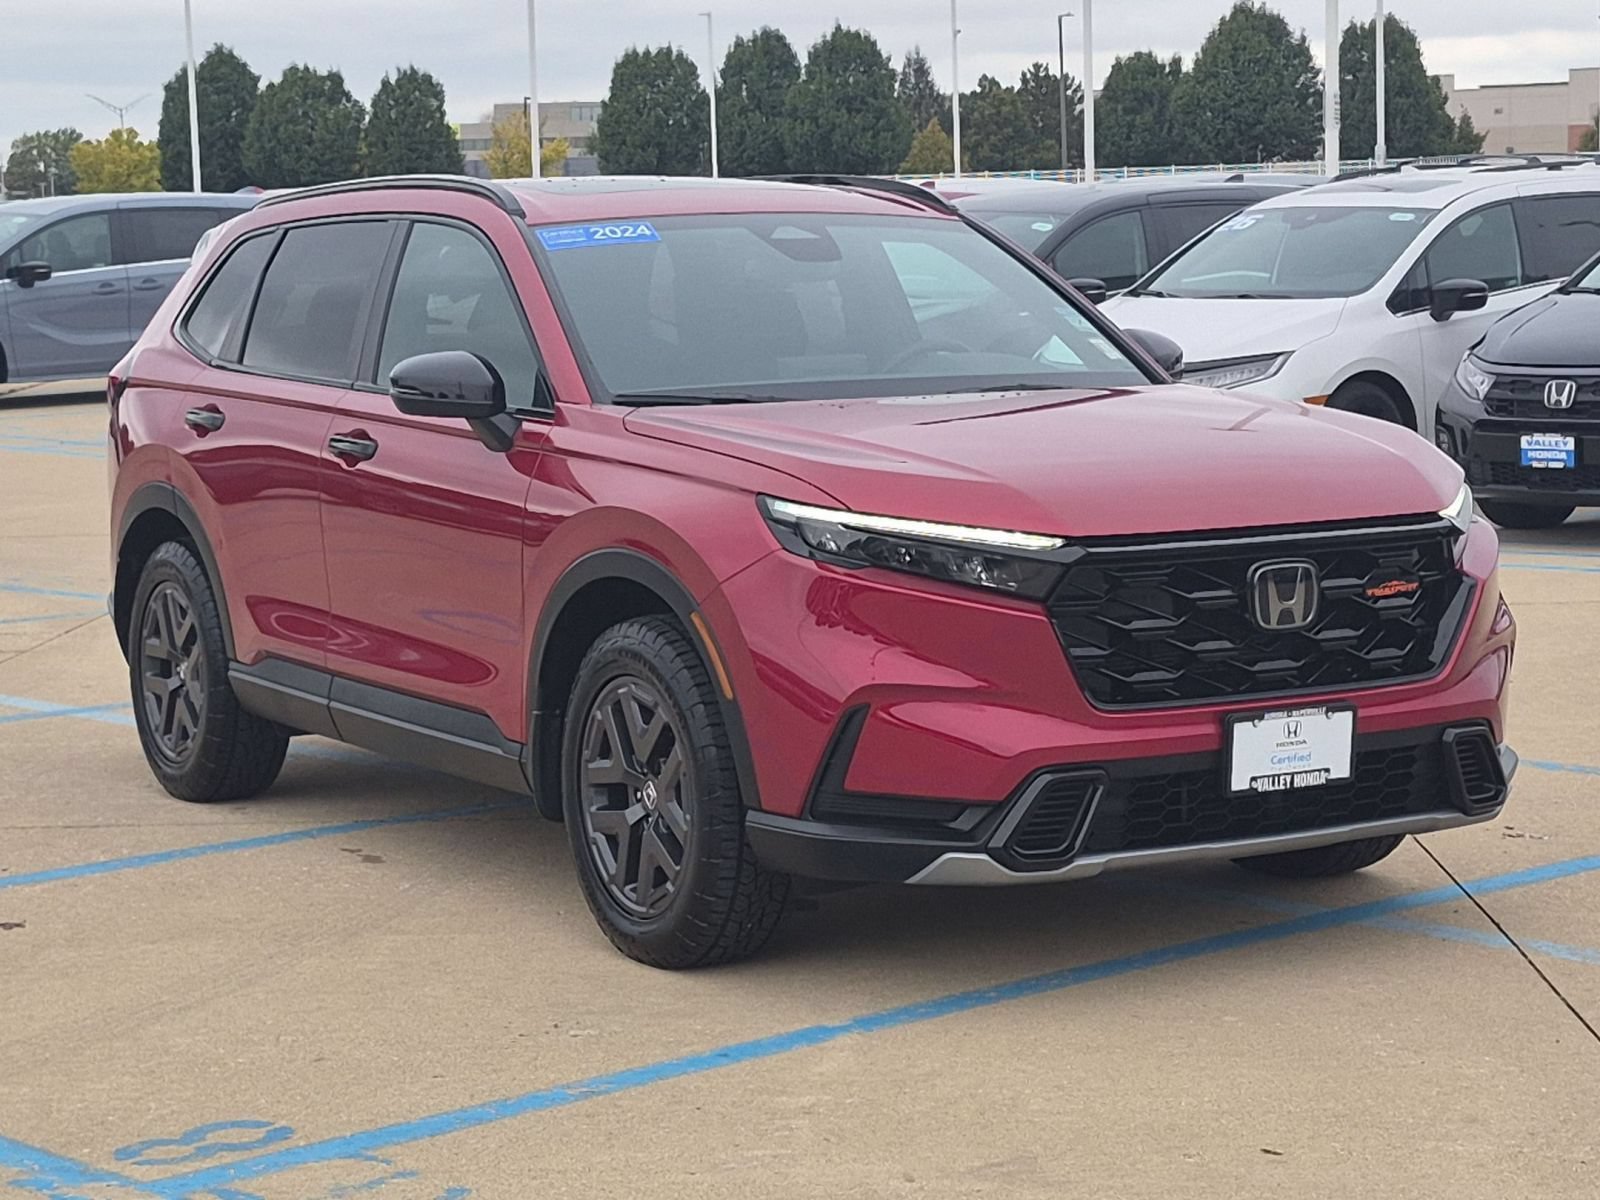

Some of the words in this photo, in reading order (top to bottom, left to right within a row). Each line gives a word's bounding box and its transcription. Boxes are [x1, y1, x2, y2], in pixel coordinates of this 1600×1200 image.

[589, 225, 652, 240] 2024
[1526, 439, 1569, 448] VALLEY
[1527, 450, 1568, 460] HONDA
[1275, 739, 1308, 749] HONDA
[1270, 752, 1312, 766] Certified
[1256, 774, 1293, 793] VALLEY
[1293, 770, 1327, 788] HONDA
